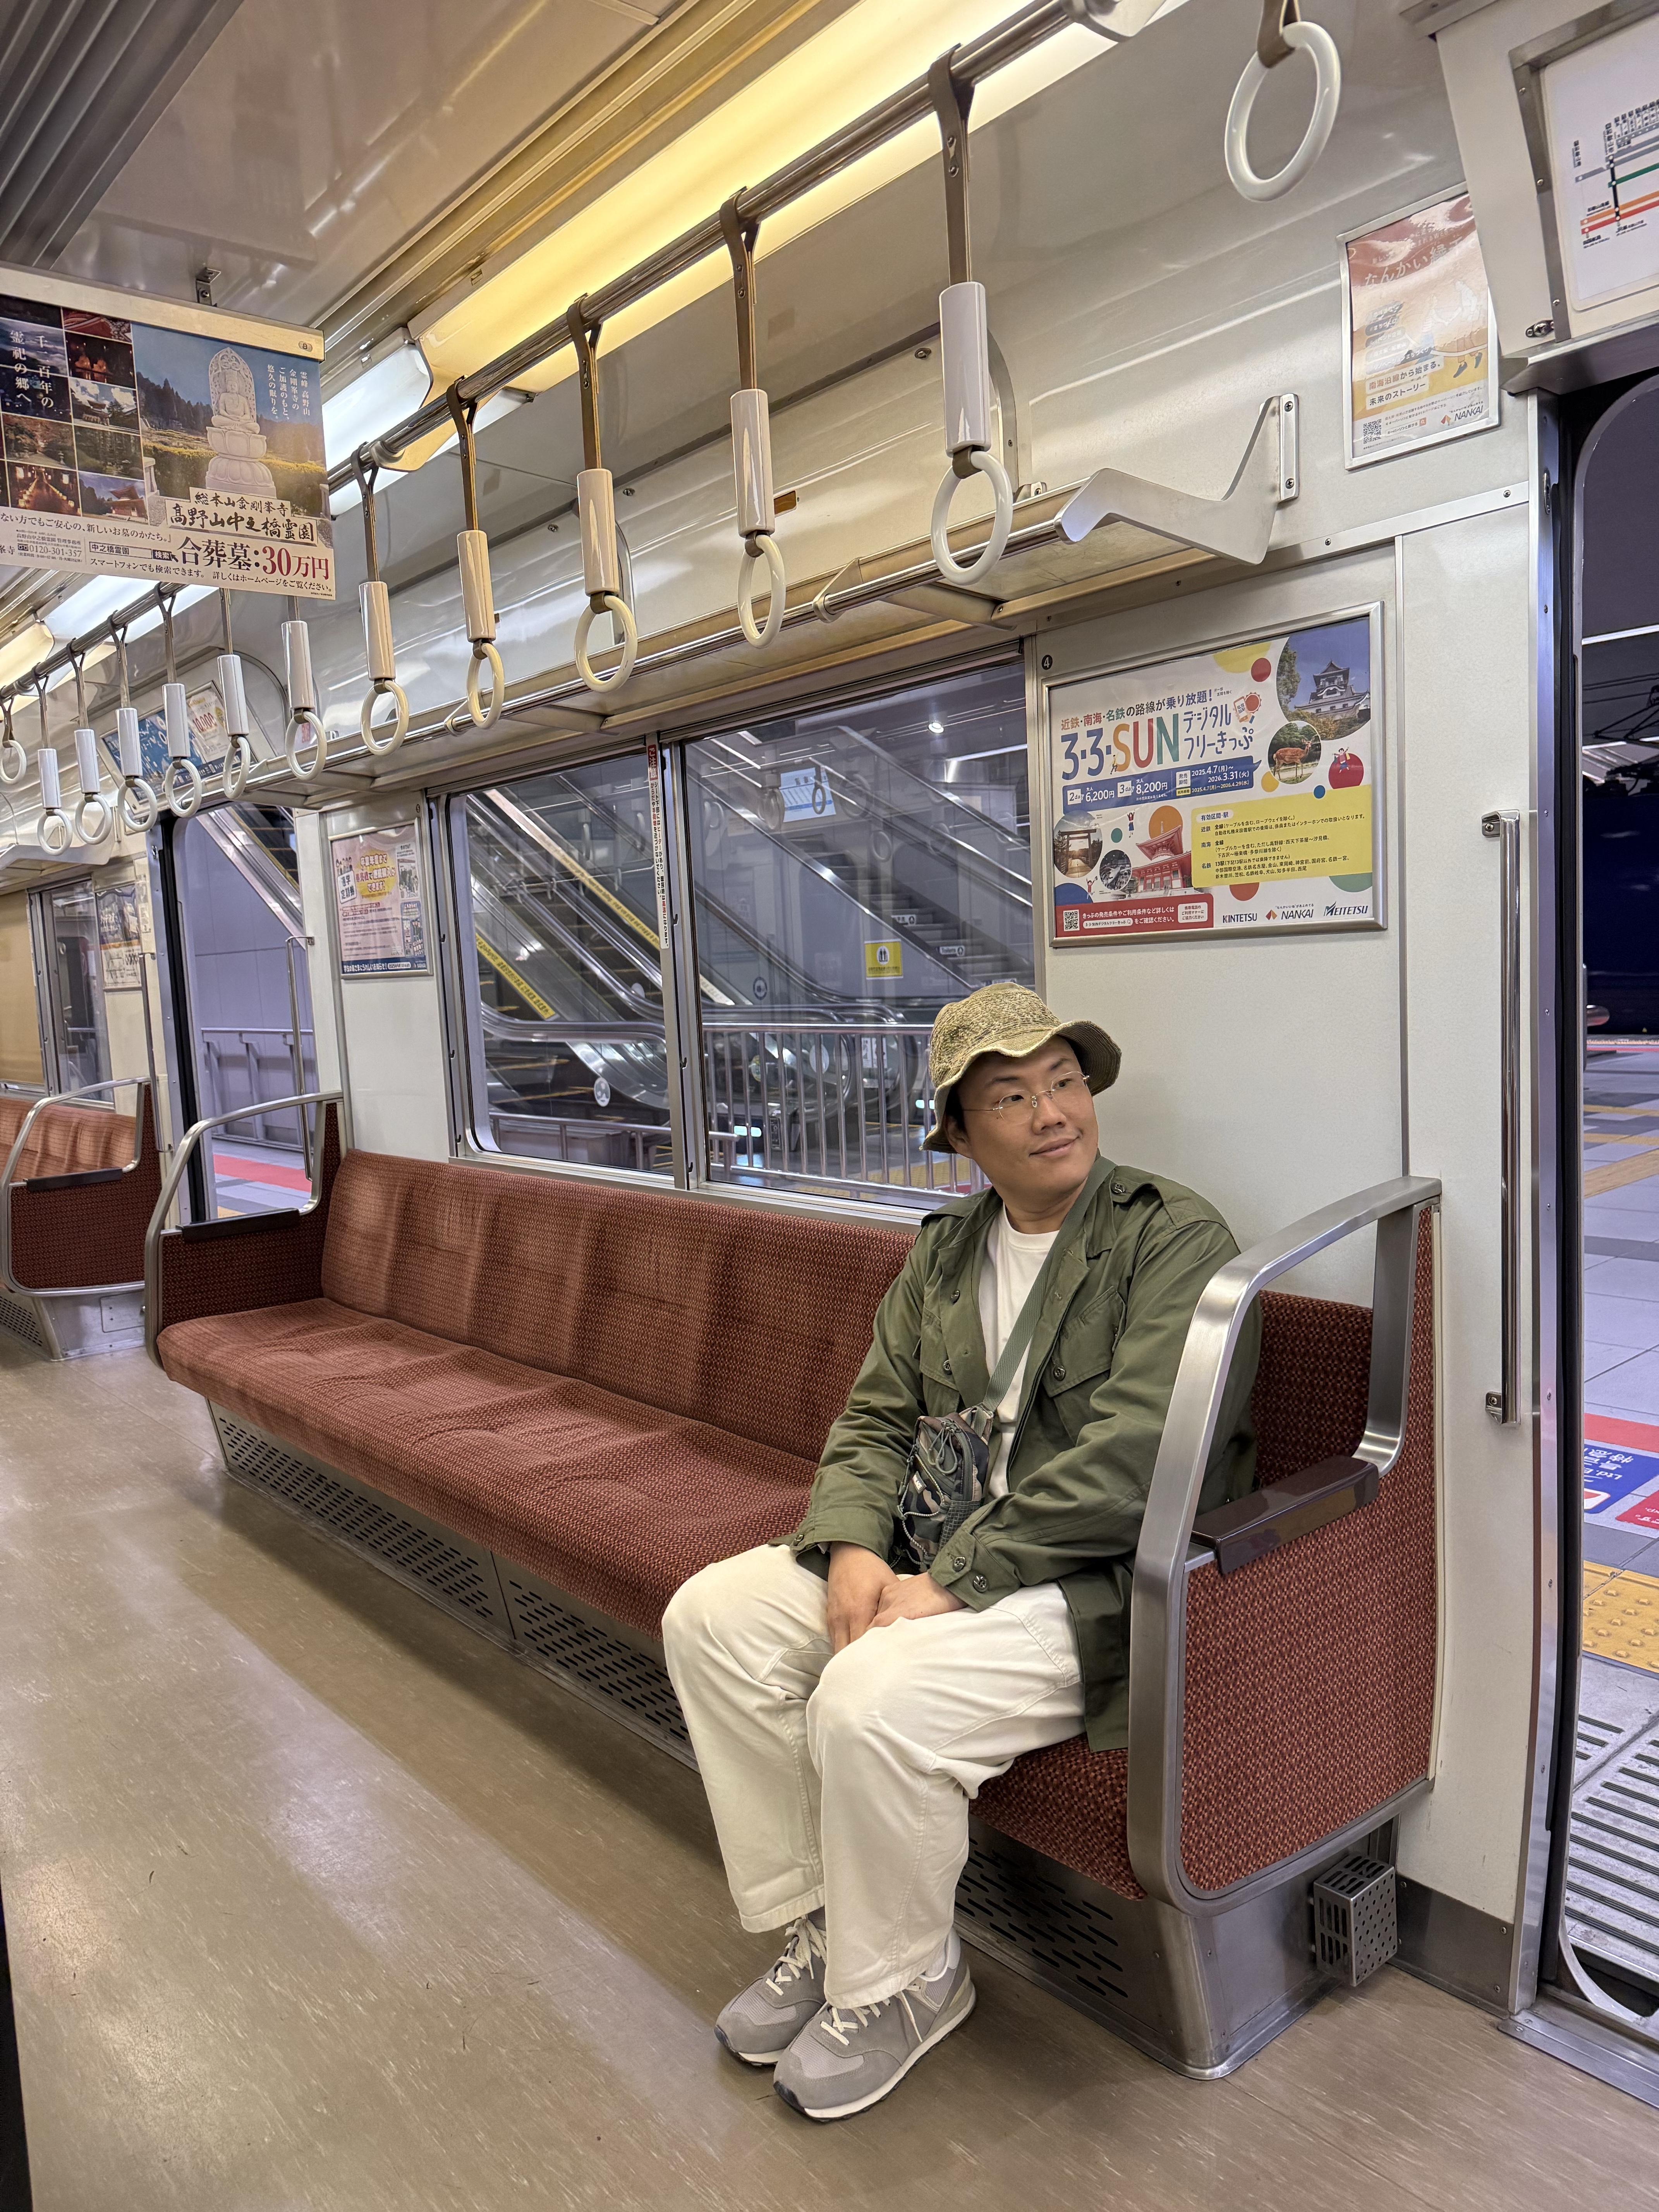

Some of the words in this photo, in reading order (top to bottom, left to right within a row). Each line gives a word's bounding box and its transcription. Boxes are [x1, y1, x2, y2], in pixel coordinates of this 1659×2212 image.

[1369, 383, 1425, 406] 未来のストーリー
[1454, 405, 1483, 421] NANKAI
[194, 491, 289, 517] 総本山金剛峯寺
[29, 545, 82, 558] 0120-301-357
[91, 544, 129, 555] 中之橋霊園
[155, 551, 170, 560] 検索
[90, 558, 204, 578] スマートフォンでも検索できます。
[212, 571, 332, 592] 詳しくはホームページをご覧ください。
[1183, 704, 1231, 733] デジタル
[1183, 726, 1254, 760] フリーきっぷ
[648, 747, 657, 778] ご注意
[1208, 771, 1249, 783] 2026.3.31(火)
[1119, 784, 1135, 794] 3day
[1136, 781, 1168, 795] 8,200円
[1069, 792, 1084, 802] 2day
[1085, 790, 1115, 803] 6,200円
[1201, 812, 1229, 821] 有効区間・駅
[1082, 906, 1175, 919] きっぷの発売条件やご利用条件など詳しくは
[1281, 908, 1314, 920] NANKAI
[1324, 900, 1369, 917] MEITETSU
[1134, 916, 1175, 924] をご確認ください。
[1222, 913, 1257, 923] KINTETSU
[1595, 1470, 1623, 1480] Ltd.
